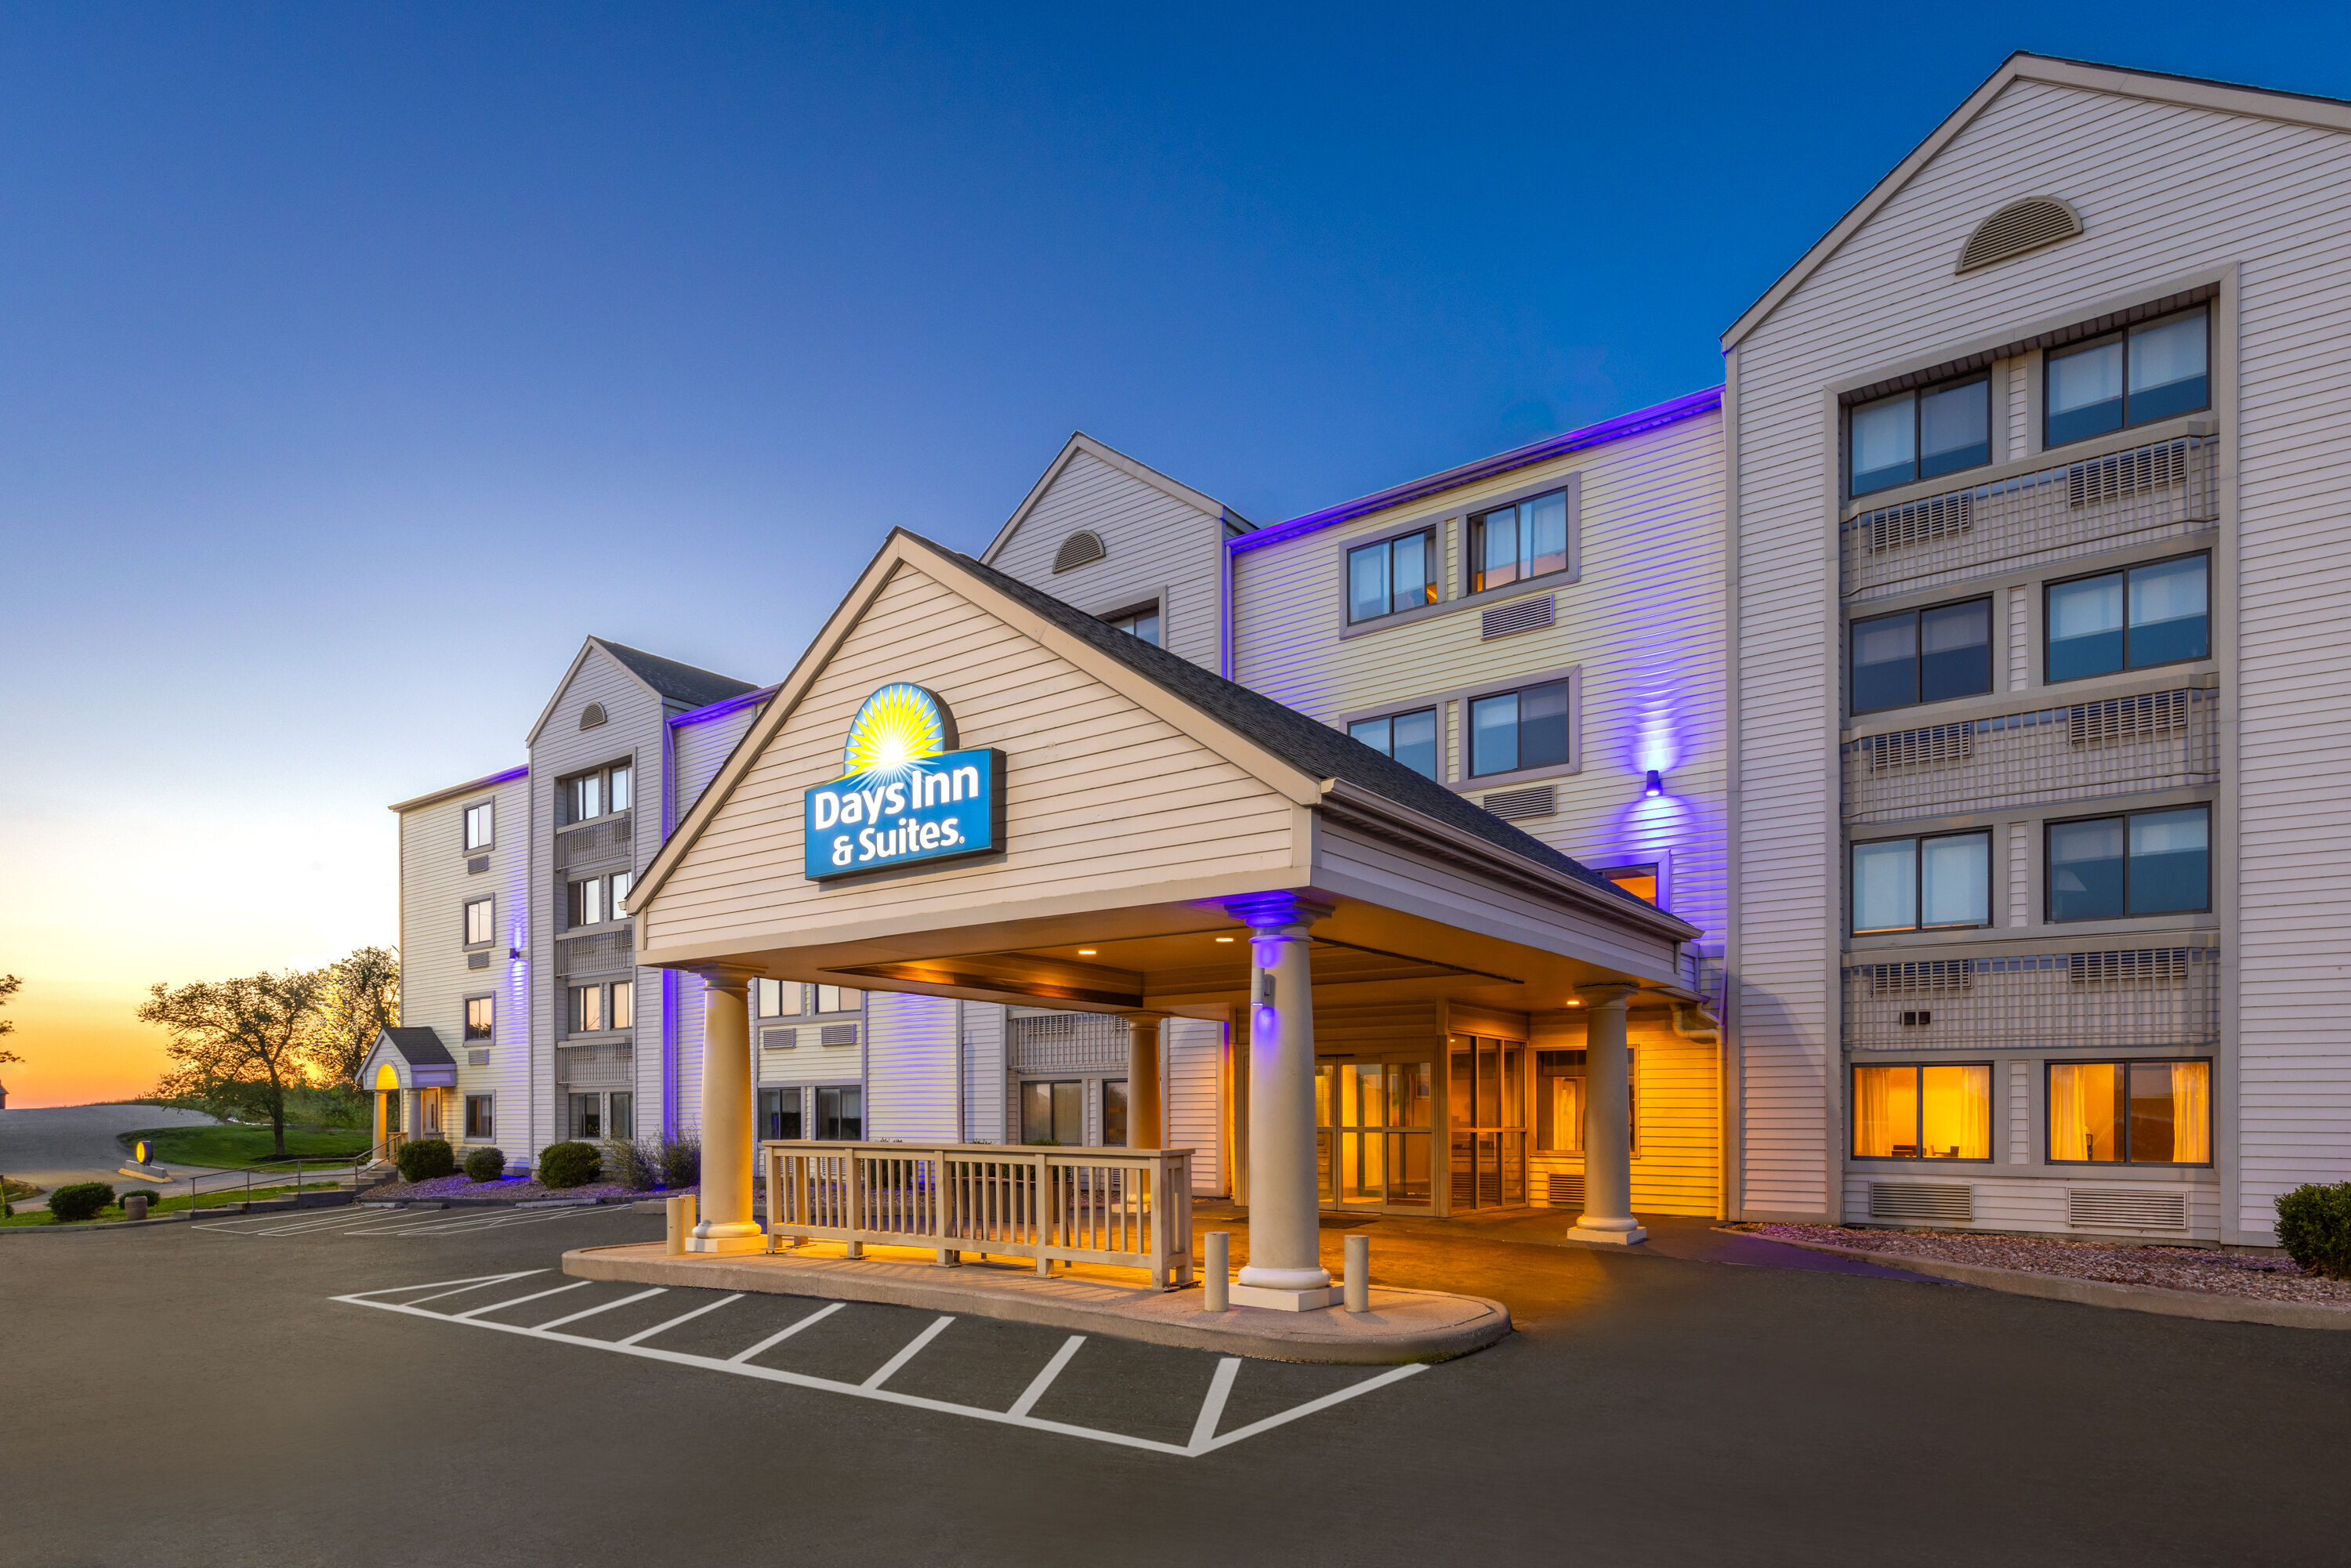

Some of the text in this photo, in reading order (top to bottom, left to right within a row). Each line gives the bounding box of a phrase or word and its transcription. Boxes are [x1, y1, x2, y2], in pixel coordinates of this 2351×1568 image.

[815, 766, 978, 830] Days Inn
[831, 835, 853, 866] &
